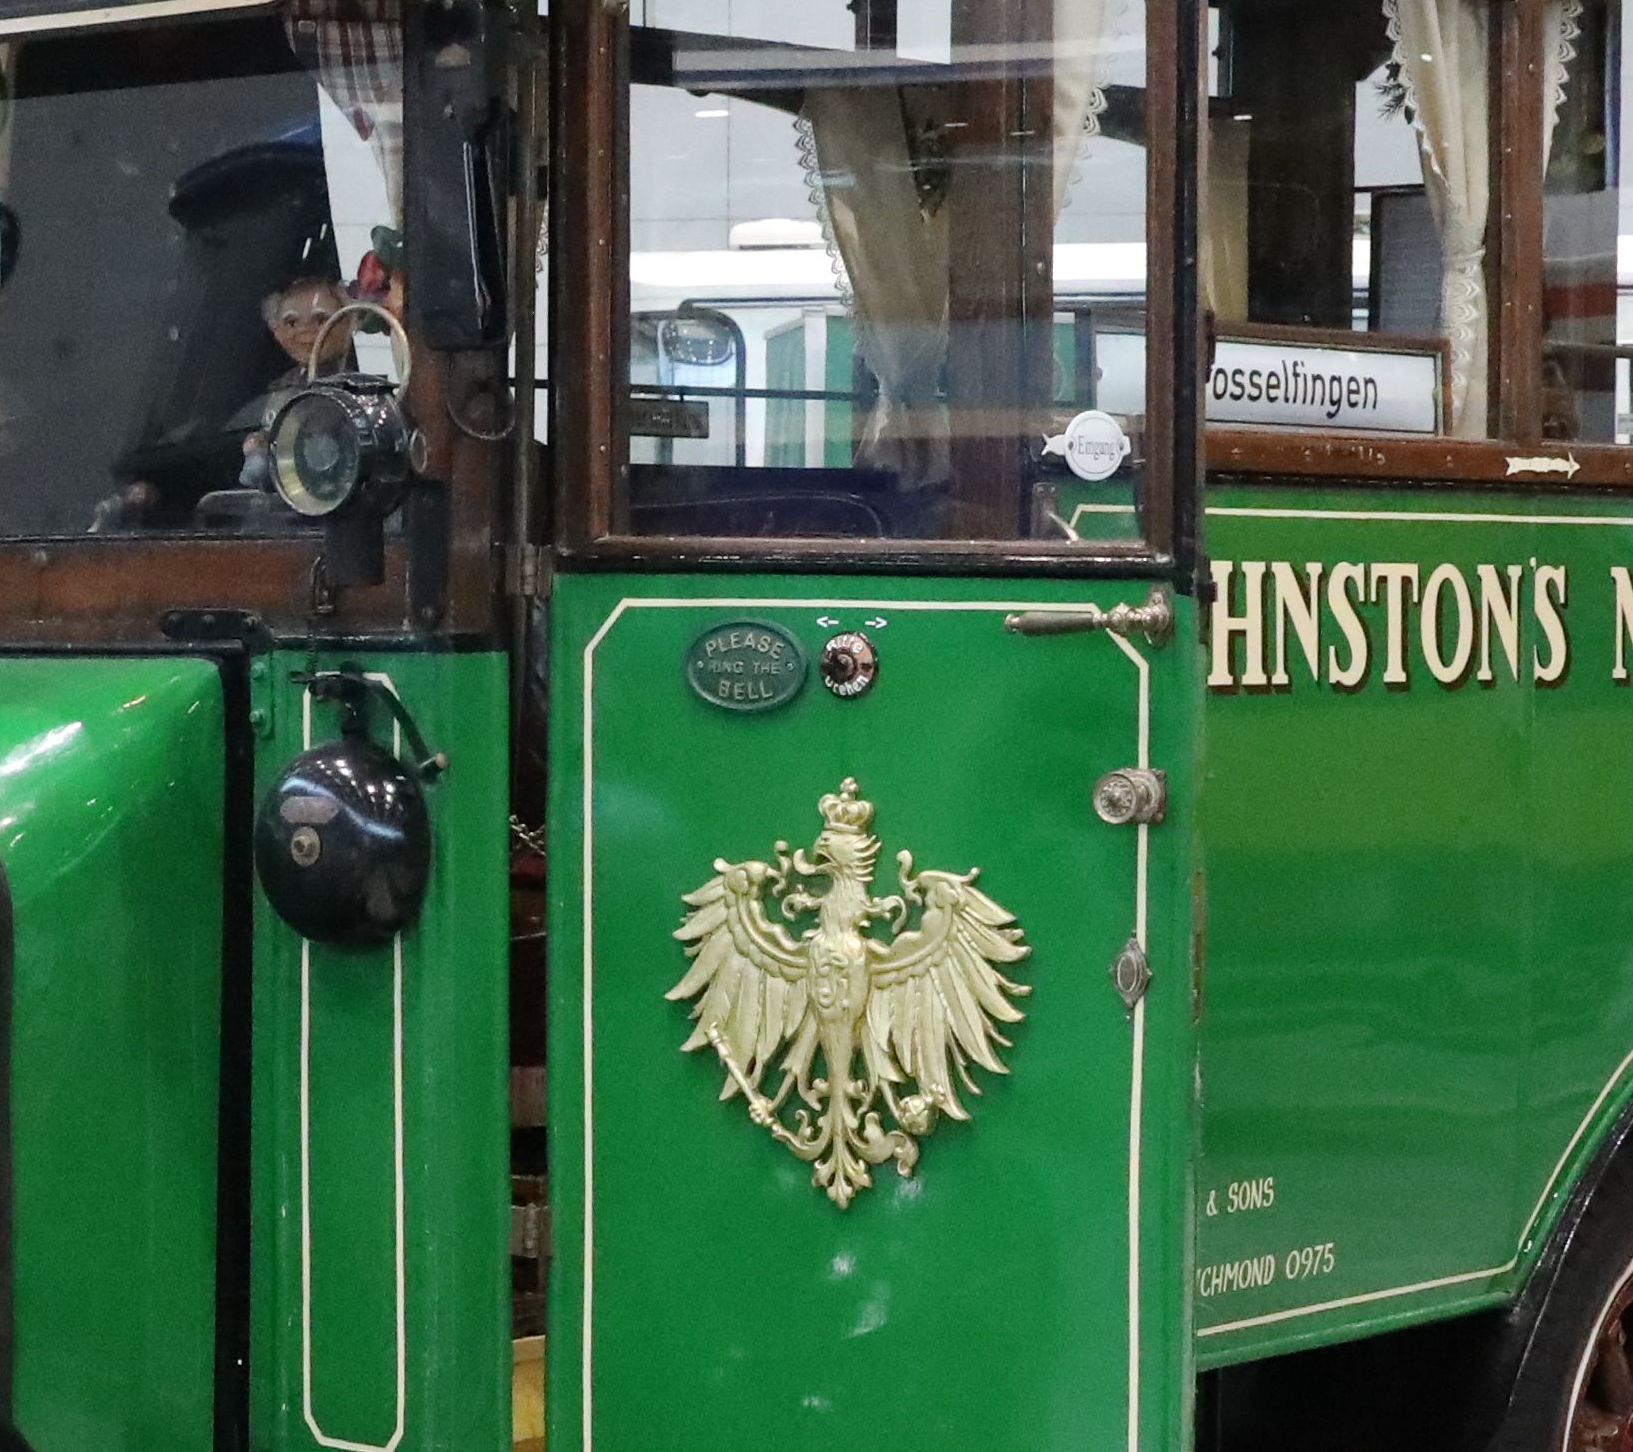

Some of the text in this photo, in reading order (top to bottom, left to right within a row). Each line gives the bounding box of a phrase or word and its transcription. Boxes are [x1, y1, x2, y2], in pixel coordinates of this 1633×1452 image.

[1206, 360, 1379, 419] osselfingen
[1077, 434, 1117, 461] Eingang
[1206, 556, 1569, 690] HNSTON'S
[705, 632, 786, 660] PLEASE
[707, 660, 782, 675] RING THE
[717, 680, 774, 701] BELL
[1205, 1176, 1275, 1217] & SONS
[1285, 1242, 1336, 1282] 0975
